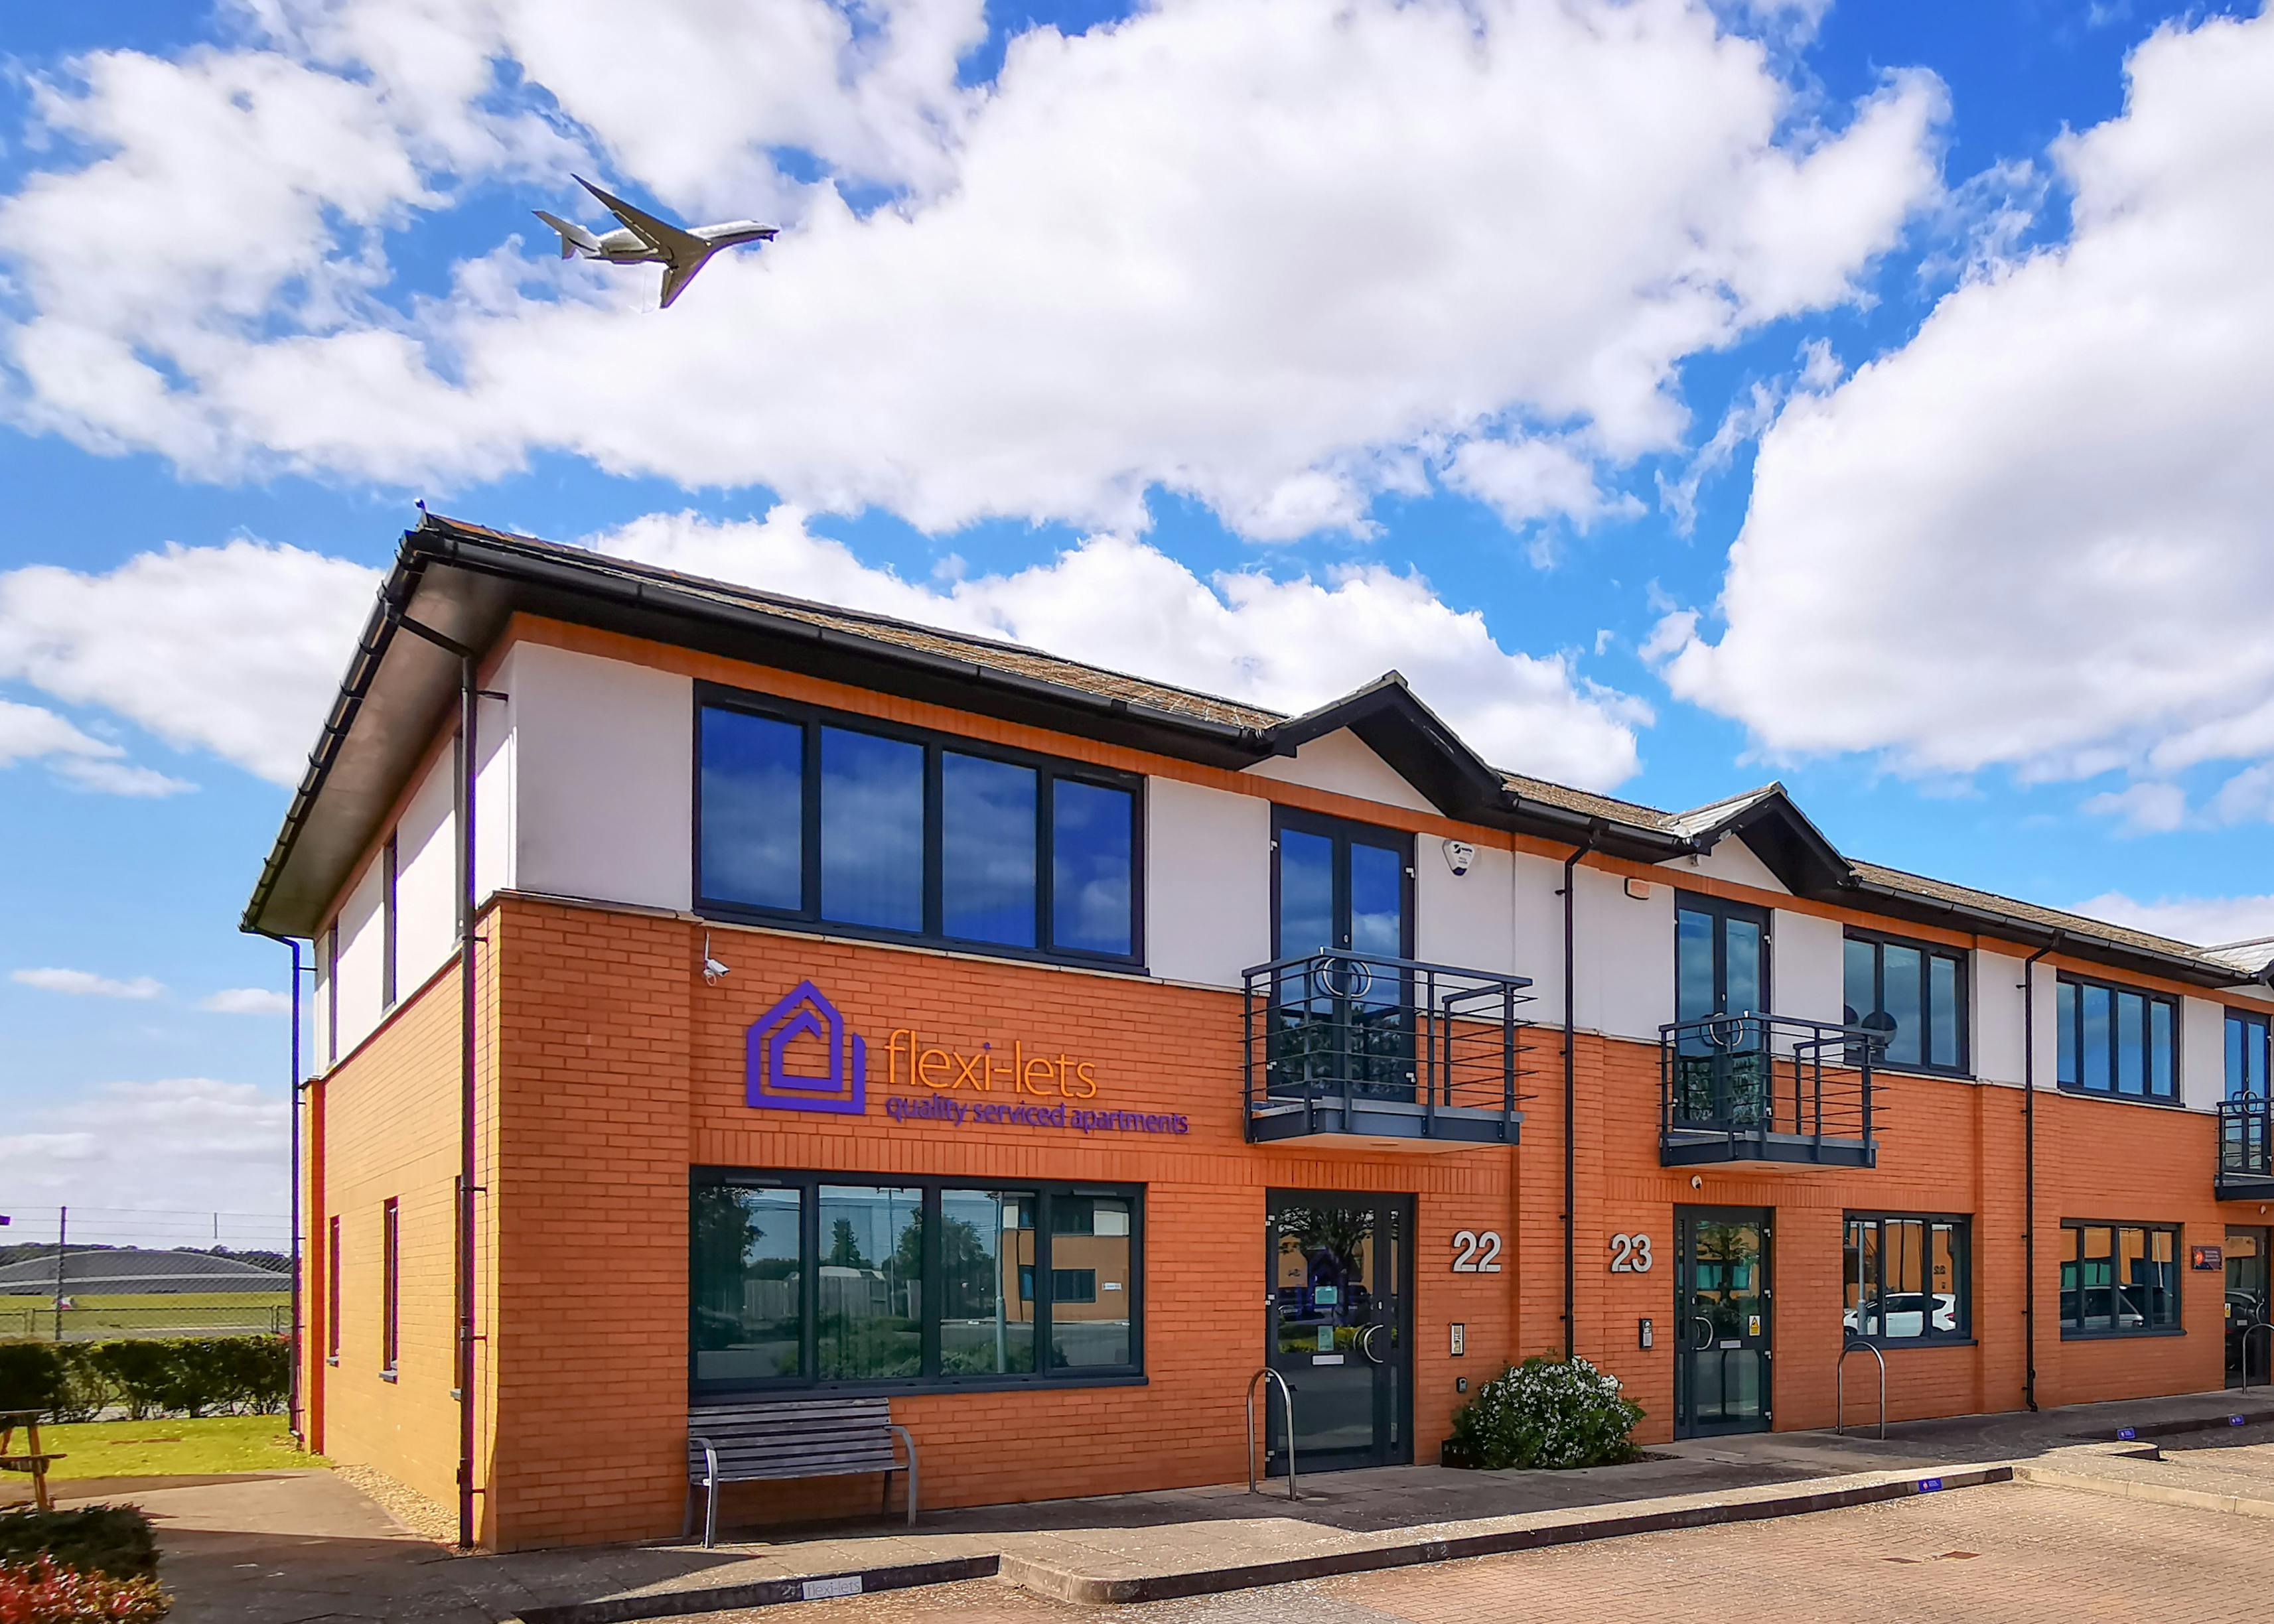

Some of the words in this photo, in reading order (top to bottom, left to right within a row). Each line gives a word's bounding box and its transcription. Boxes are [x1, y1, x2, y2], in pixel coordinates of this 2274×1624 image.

[884, 1029, 1097, 1099] flexi-lets
[885, 1093, 967, 1128] quality
[973, 1099, 1066, 1128] serviced
[1070, 1109, 1189, 1135] apartments
[1452, 1230, 1502, 1272] 22
[1610, 1233, 1653, 1272] 23
[807, 1580, 861, 1597] flexi-lets
